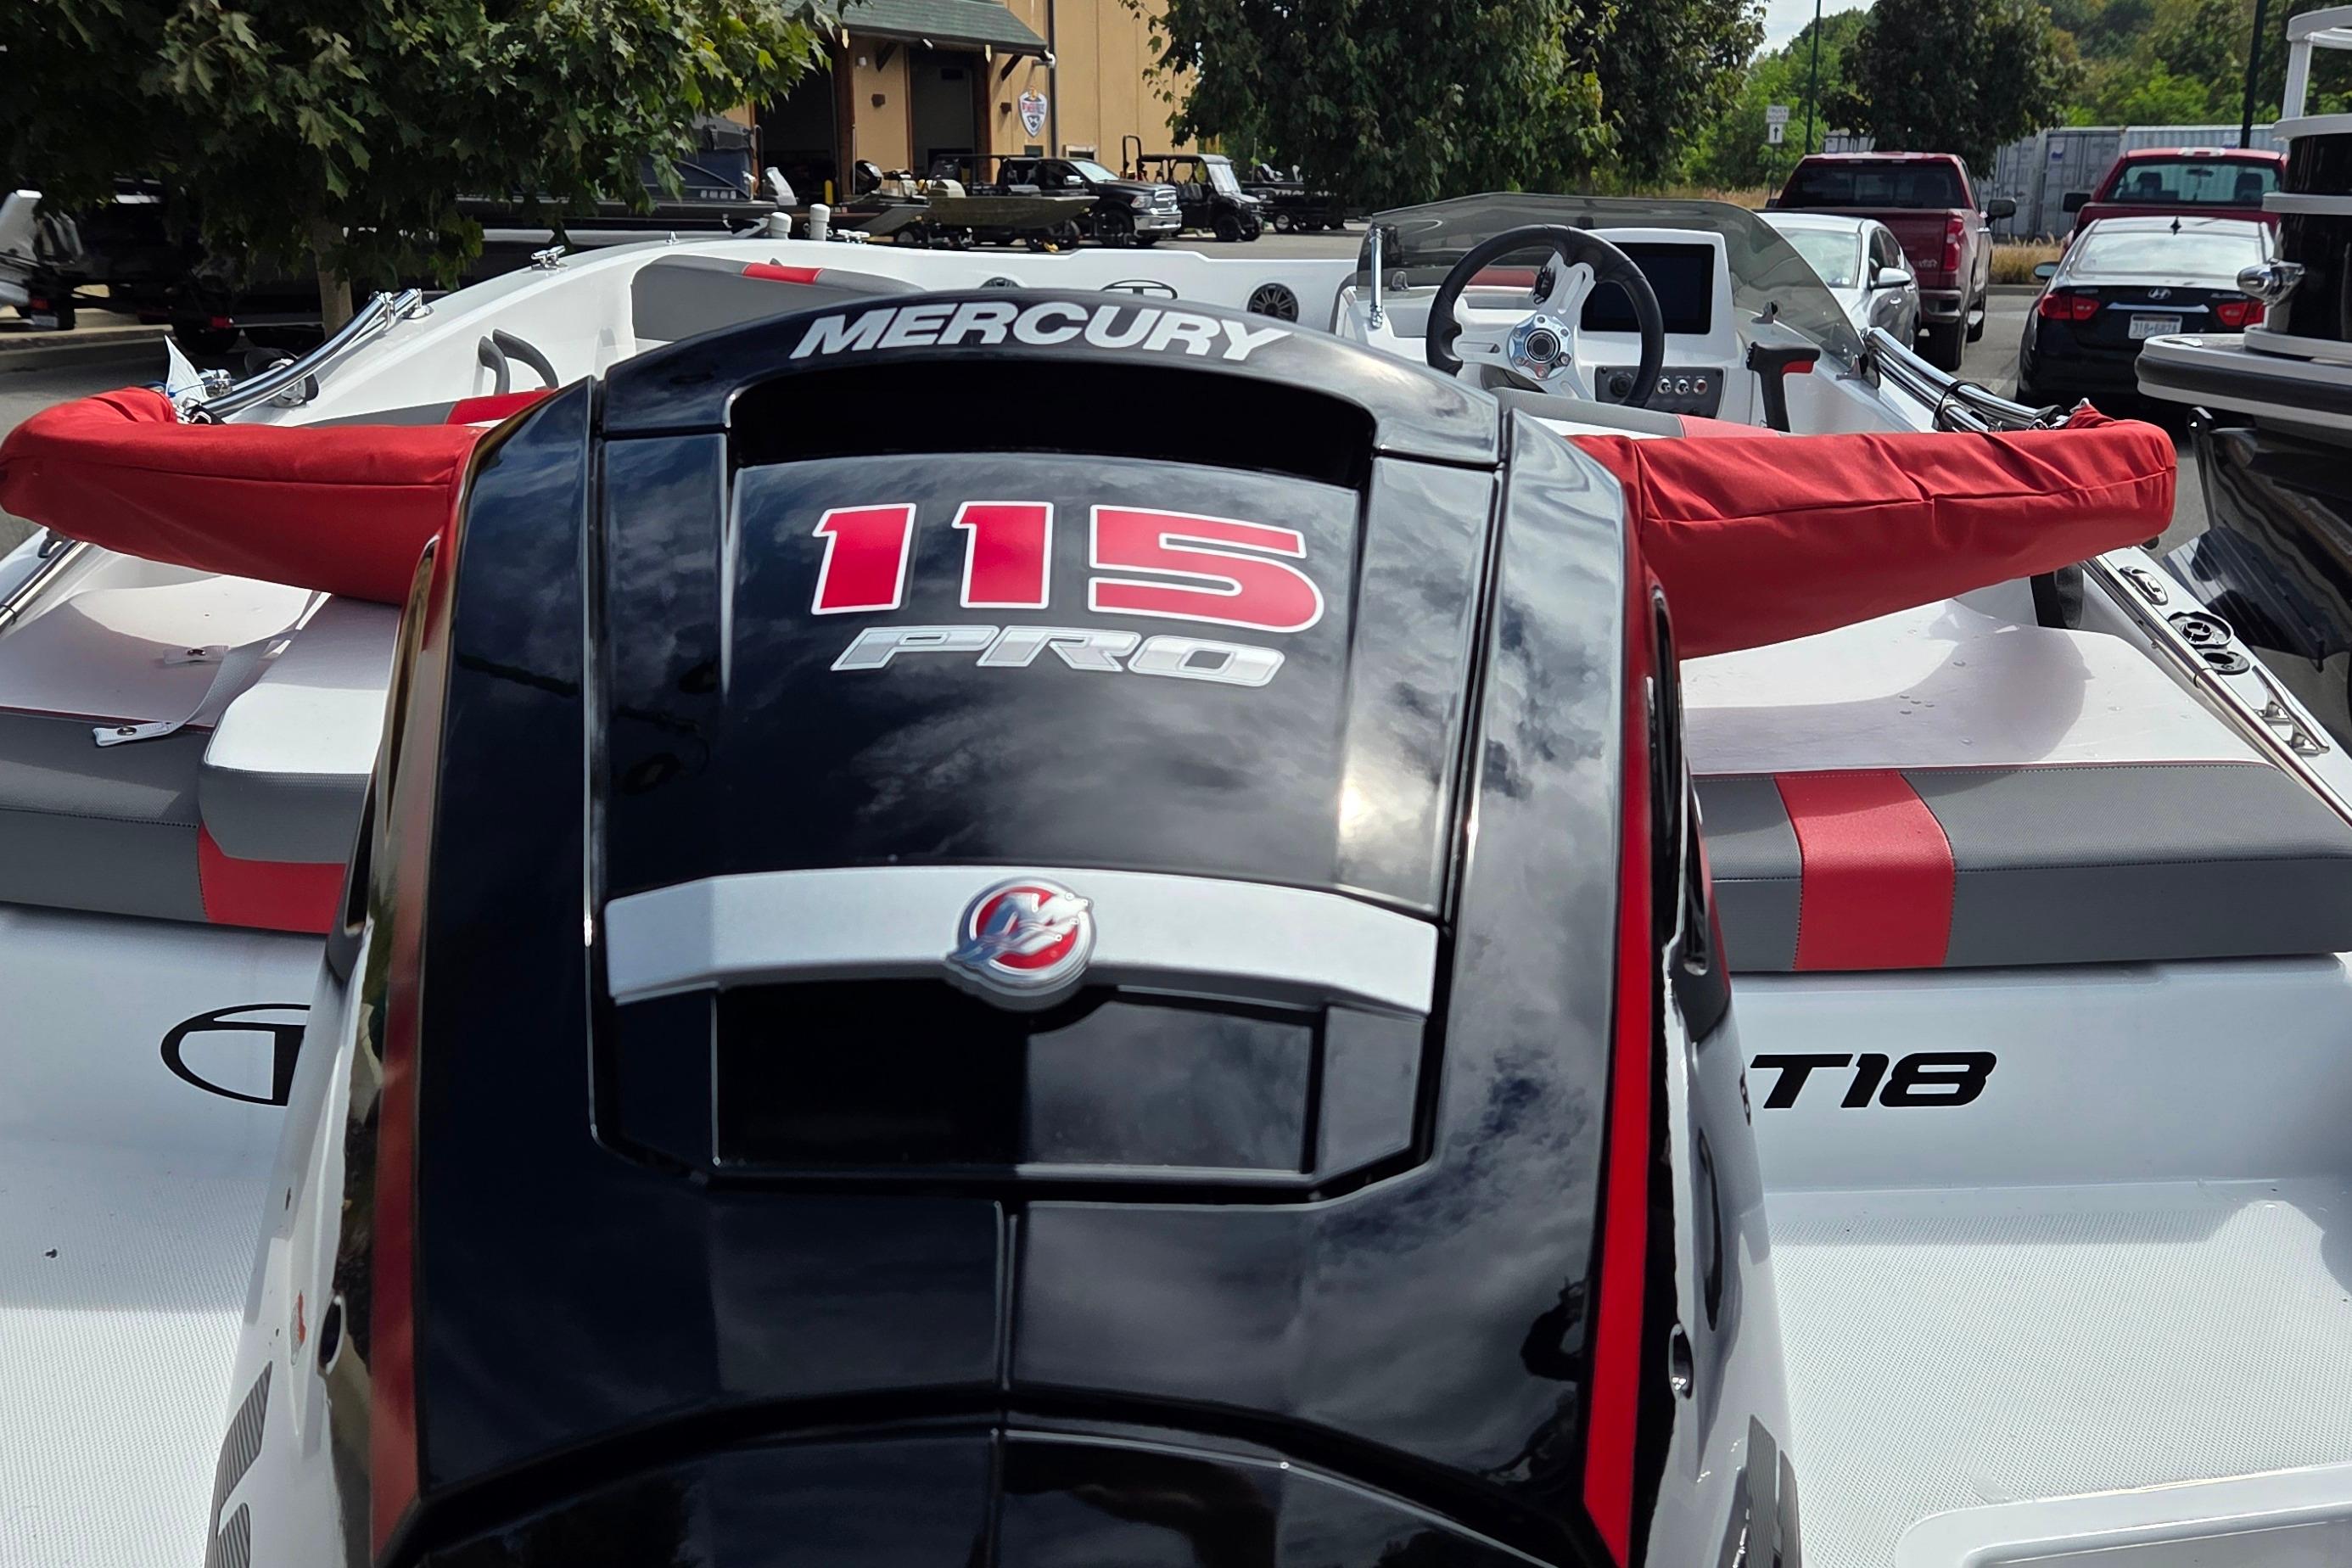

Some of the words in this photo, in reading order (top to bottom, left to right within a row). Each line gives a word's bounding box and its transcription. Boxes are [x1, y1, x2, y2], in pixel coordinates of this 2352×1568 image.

[789, 301, 1292, 361] MERCURY
[810, 501, 1325, 633] 115
[831, 624, 1285, 687] PRO
[1750, 1051, 1997, 1108] T18
